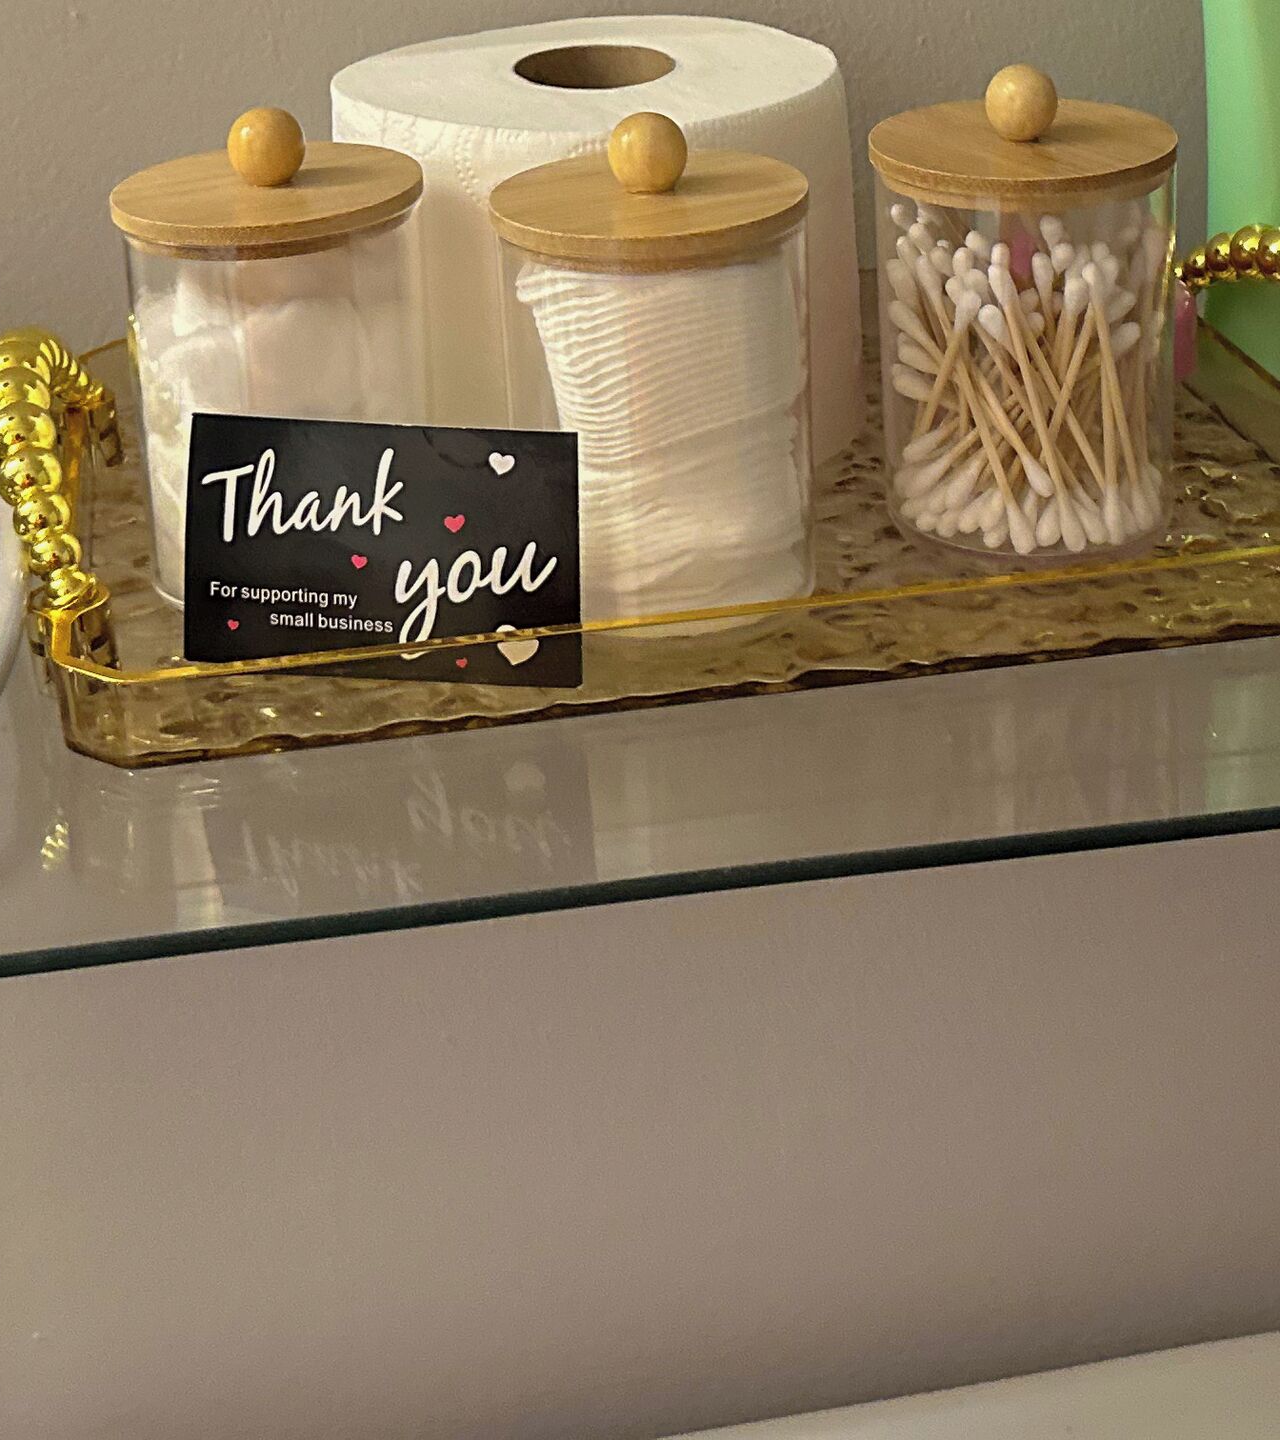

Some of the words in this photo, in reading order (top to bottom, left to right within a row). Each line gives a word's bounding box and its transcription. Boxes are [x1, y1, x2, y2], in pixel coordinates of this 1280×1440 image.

[201, 447, 405, 543] Thank
[210, 581, 238, 599] For
[241, 583, 329, 607] supporting
[333, 591, 358, 609] my
[269, 612, 314, 629] small
[318, 612, 394, 633] business
[394, 541, 558, 660] you
